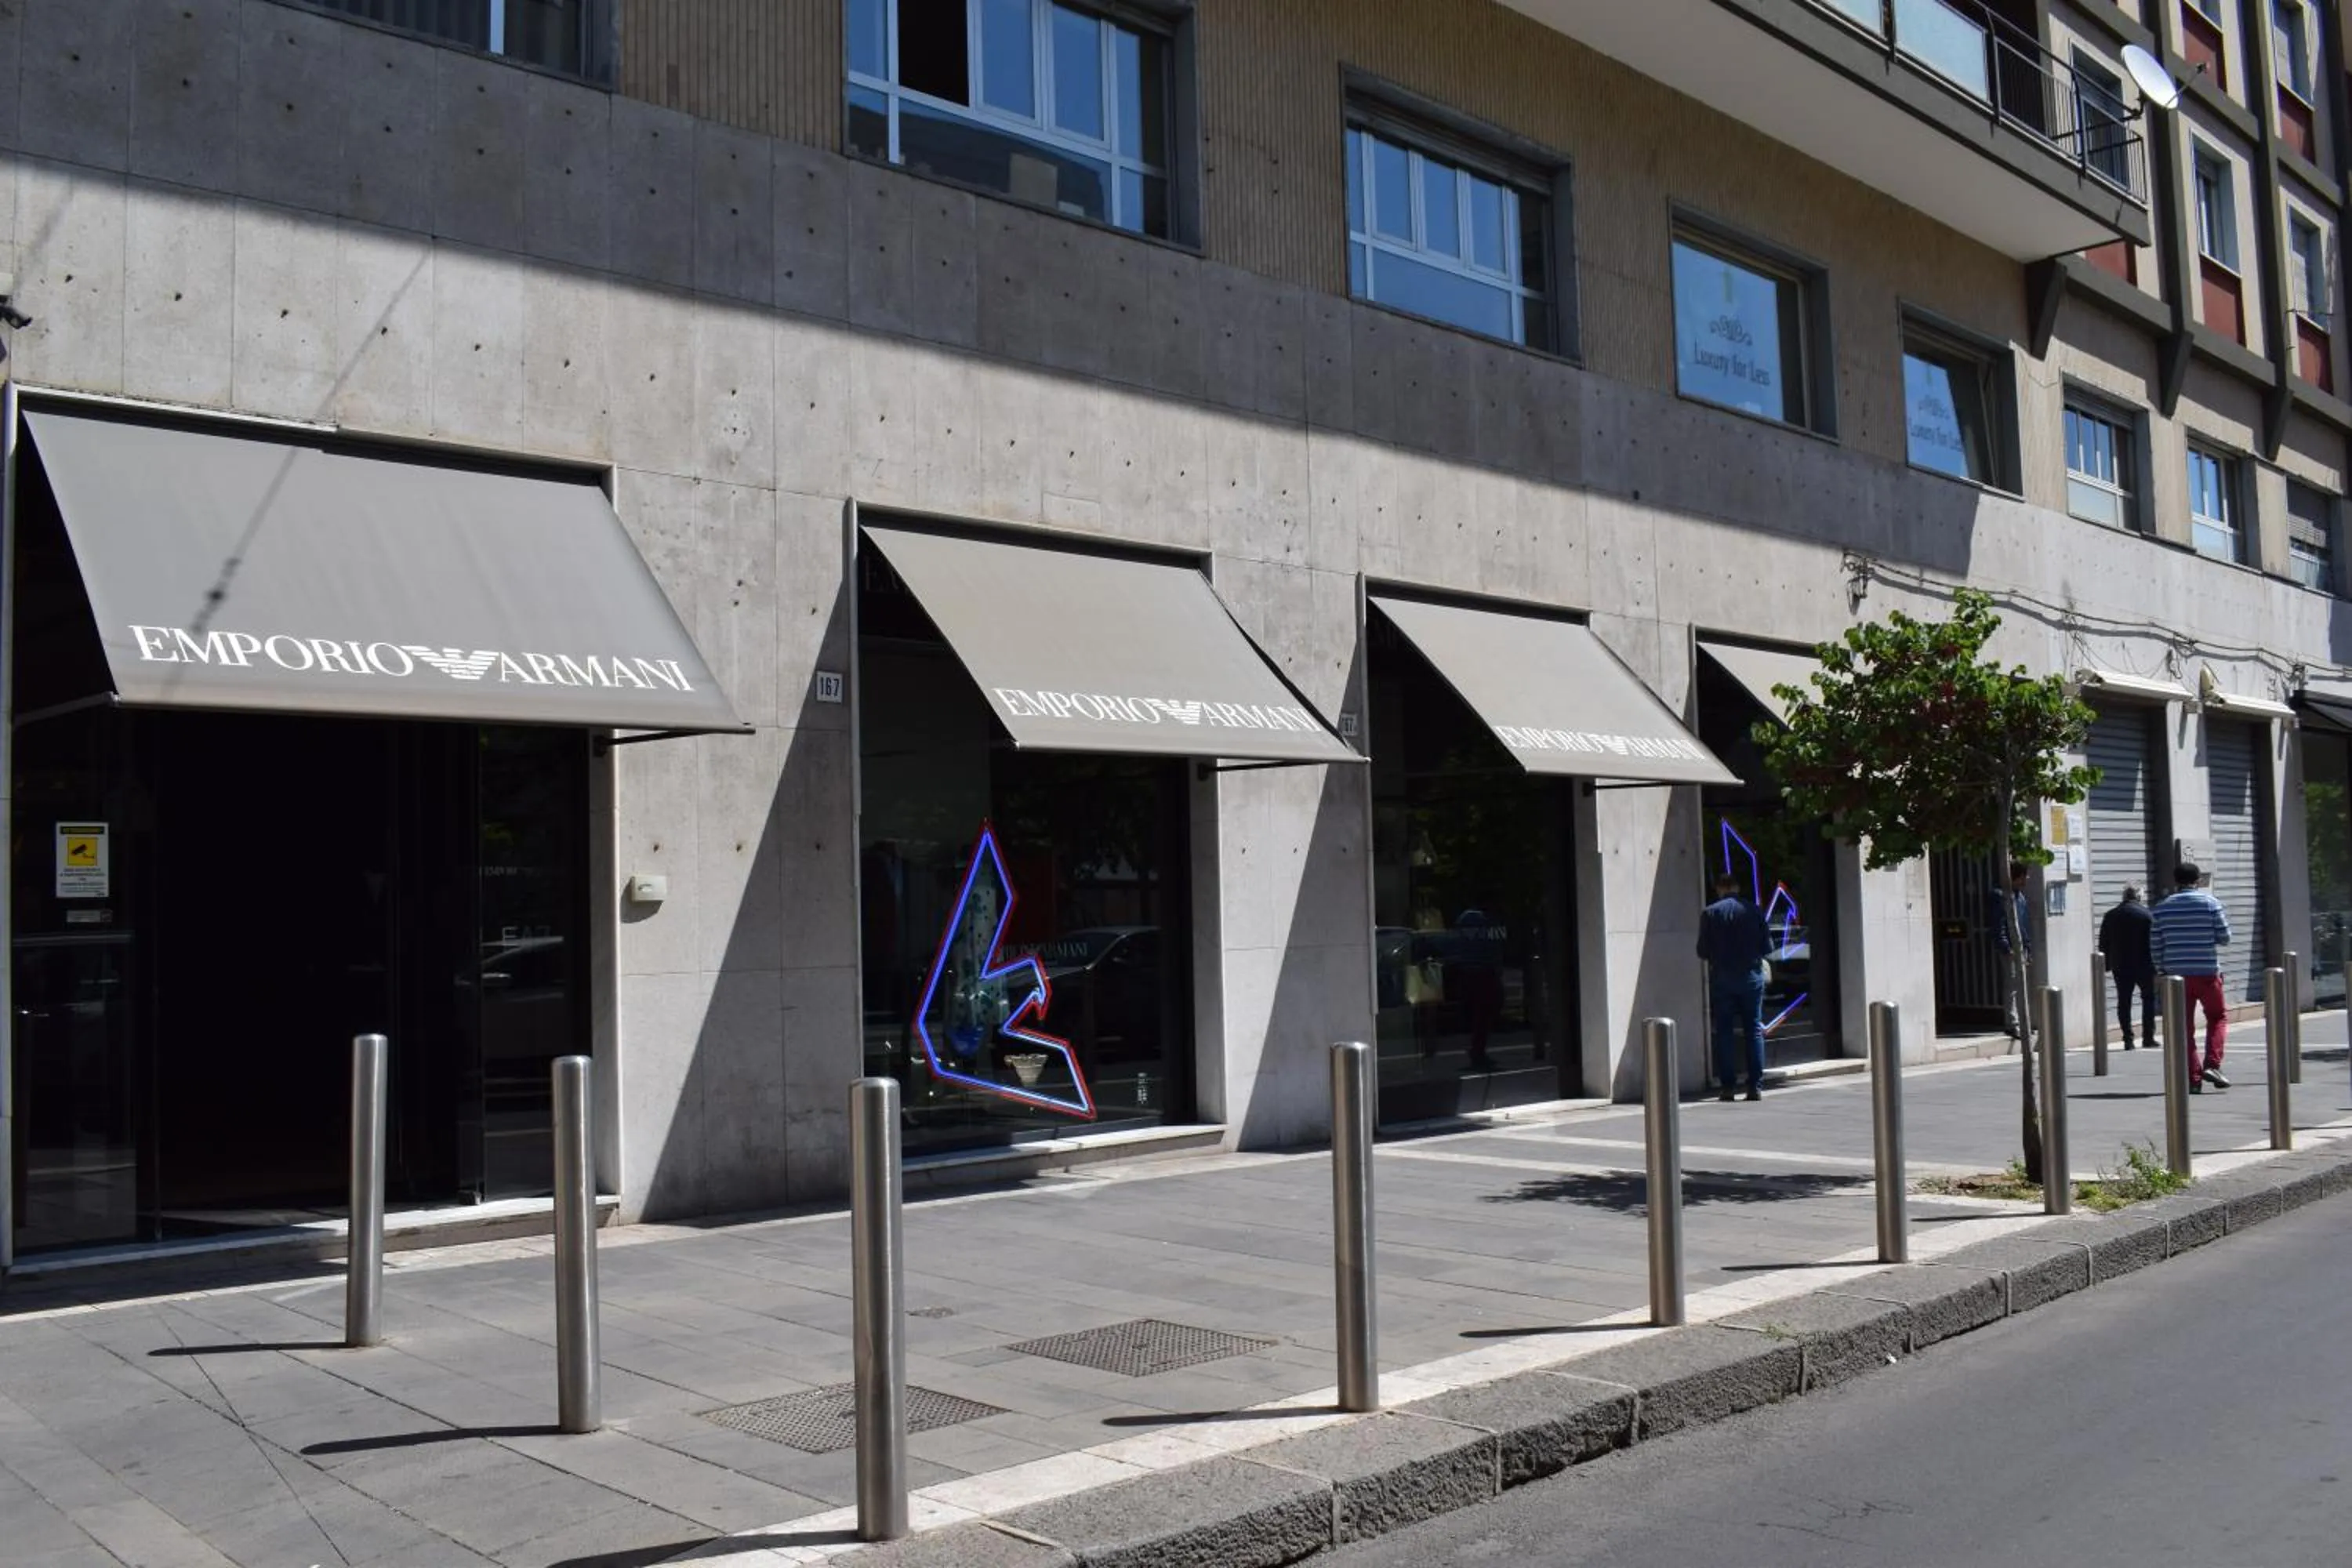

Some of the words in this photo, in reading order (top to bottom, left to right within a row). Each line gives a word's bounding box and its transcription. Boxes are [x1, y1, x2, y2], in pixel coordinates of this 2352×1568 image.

[1693, 337, 1730, 377] Luxury
[1733, 354, 1747, 379] for
[1749, 360, 1771, 387] Less
[128, 625, 414, 677] EMPORIO
[499, 652, 695, 691] ARMANI
[820, 677, 840, 696] 167
[993, 688, 1160, 724] EMPORIO
[1200, 702, 1323, 731] ARMANI
[1494, 727, 1604, 753] EMPORIO
[1627, 736, 1705, 759] ARMANI
